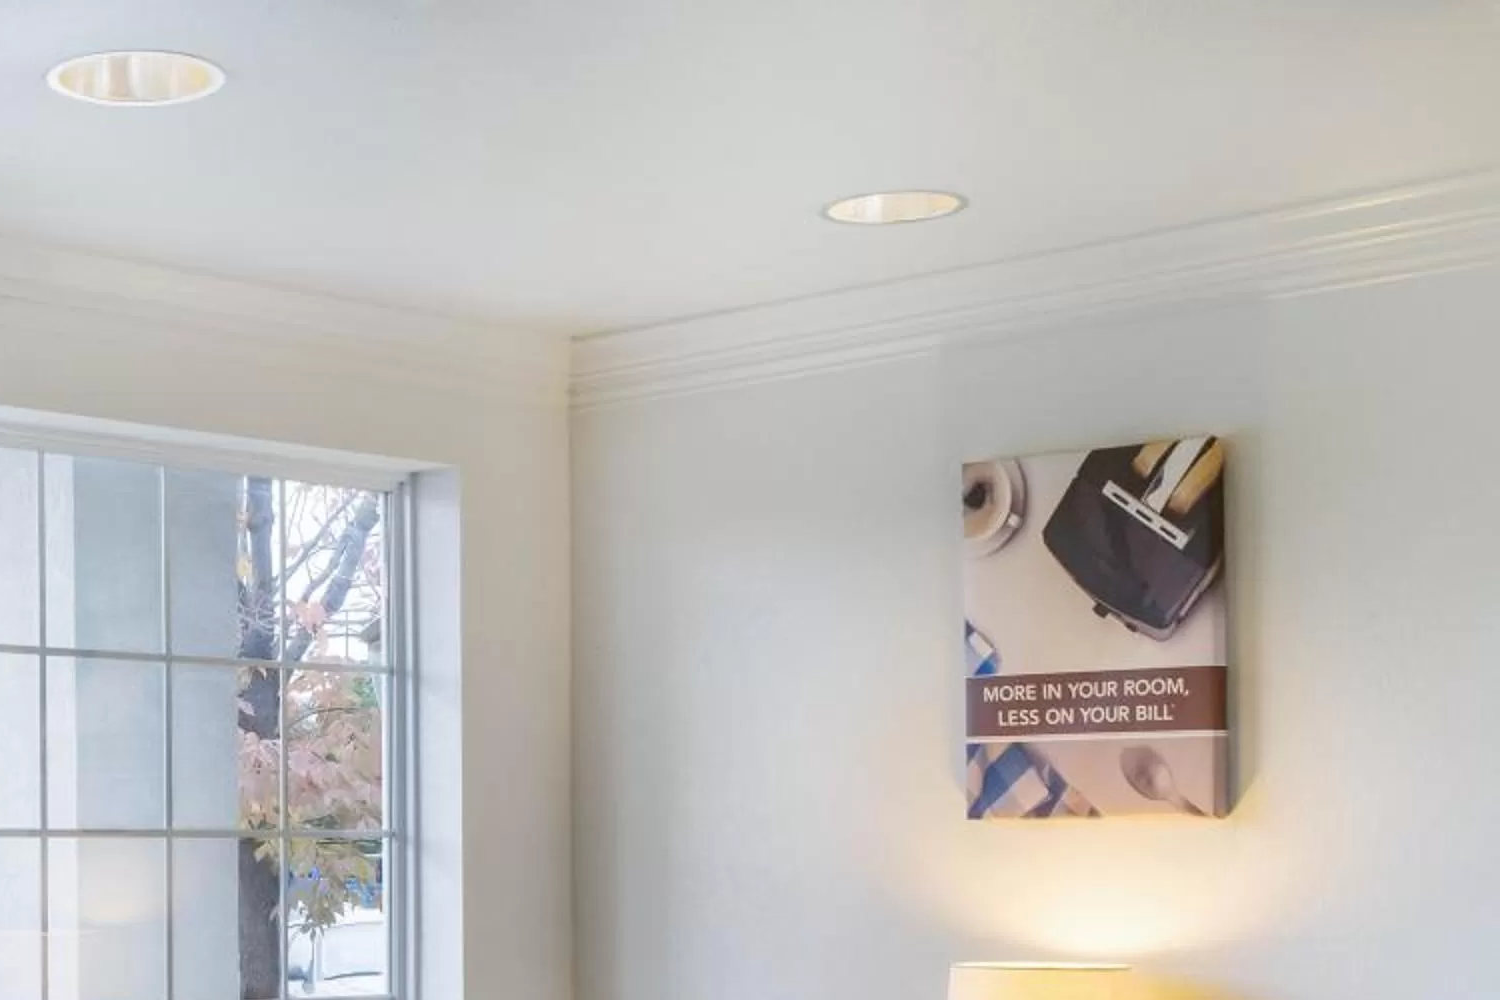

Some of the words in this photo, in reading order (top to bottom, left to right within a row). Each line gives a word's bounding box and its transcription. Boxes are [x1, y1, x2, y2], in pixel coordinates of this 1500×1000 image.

[983, 685, 1037, 702] MORE
[1043, 683, 1062, 699] IN
[1068, 681, 1117, 699] YOUR
[1124, 677, 1189, 696] ROOM,
[998, 709, 1040, 726] LESS
[1045, 708, 1075, 725] ON
[1080, 706, 1130, 724] YOUR
[1135, 704, 1174, 721] BILL
